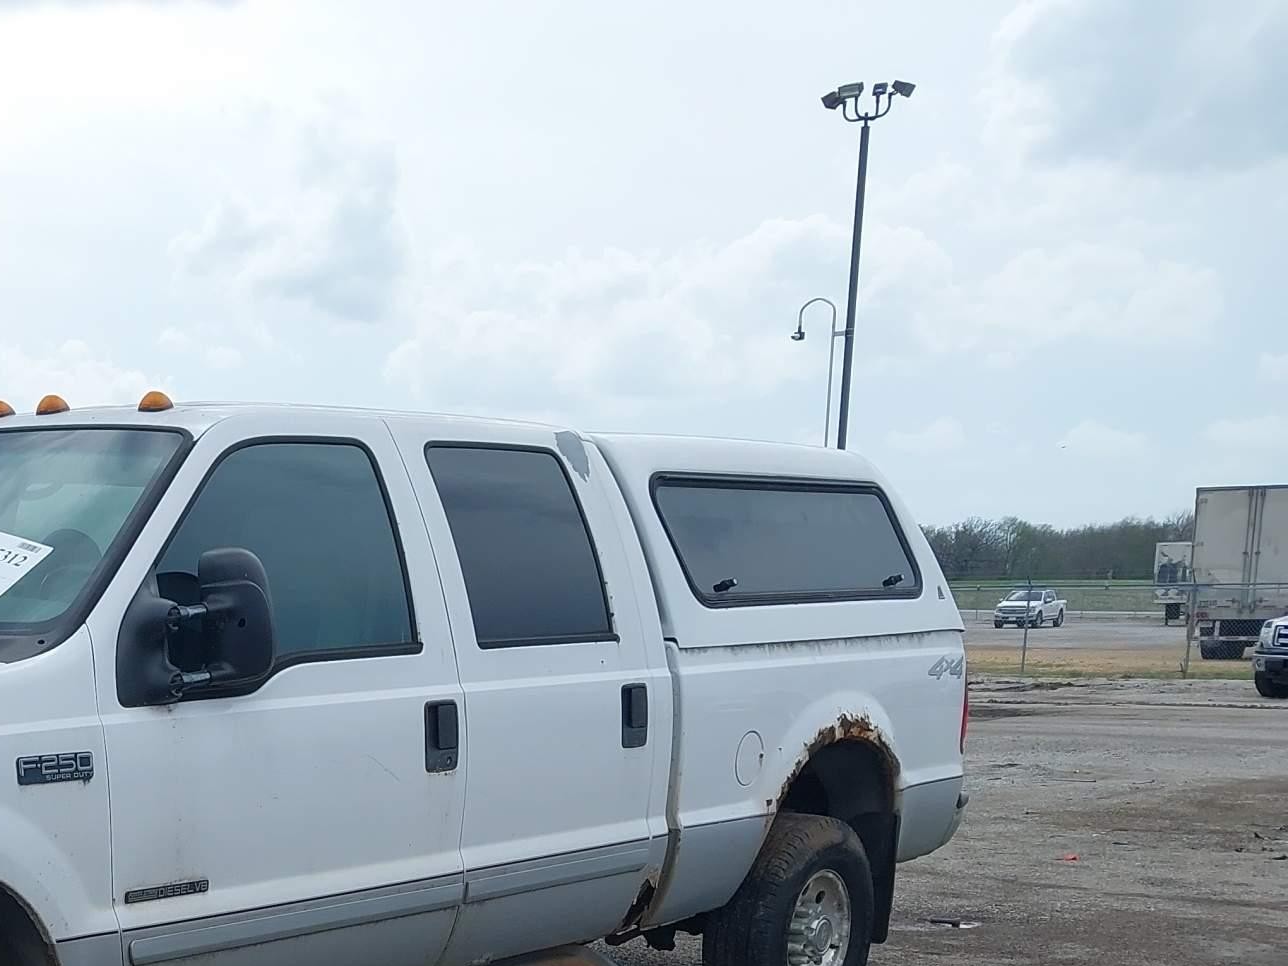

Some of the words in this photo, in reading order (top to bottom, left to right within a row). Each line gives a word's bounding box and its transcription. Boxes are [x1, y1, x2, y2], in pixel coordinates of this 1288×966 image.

[45, 772, 71, 780] SUPER
[73, 770, 93, 778] DUTY
[158, 882, 194, 898] DIESEL
